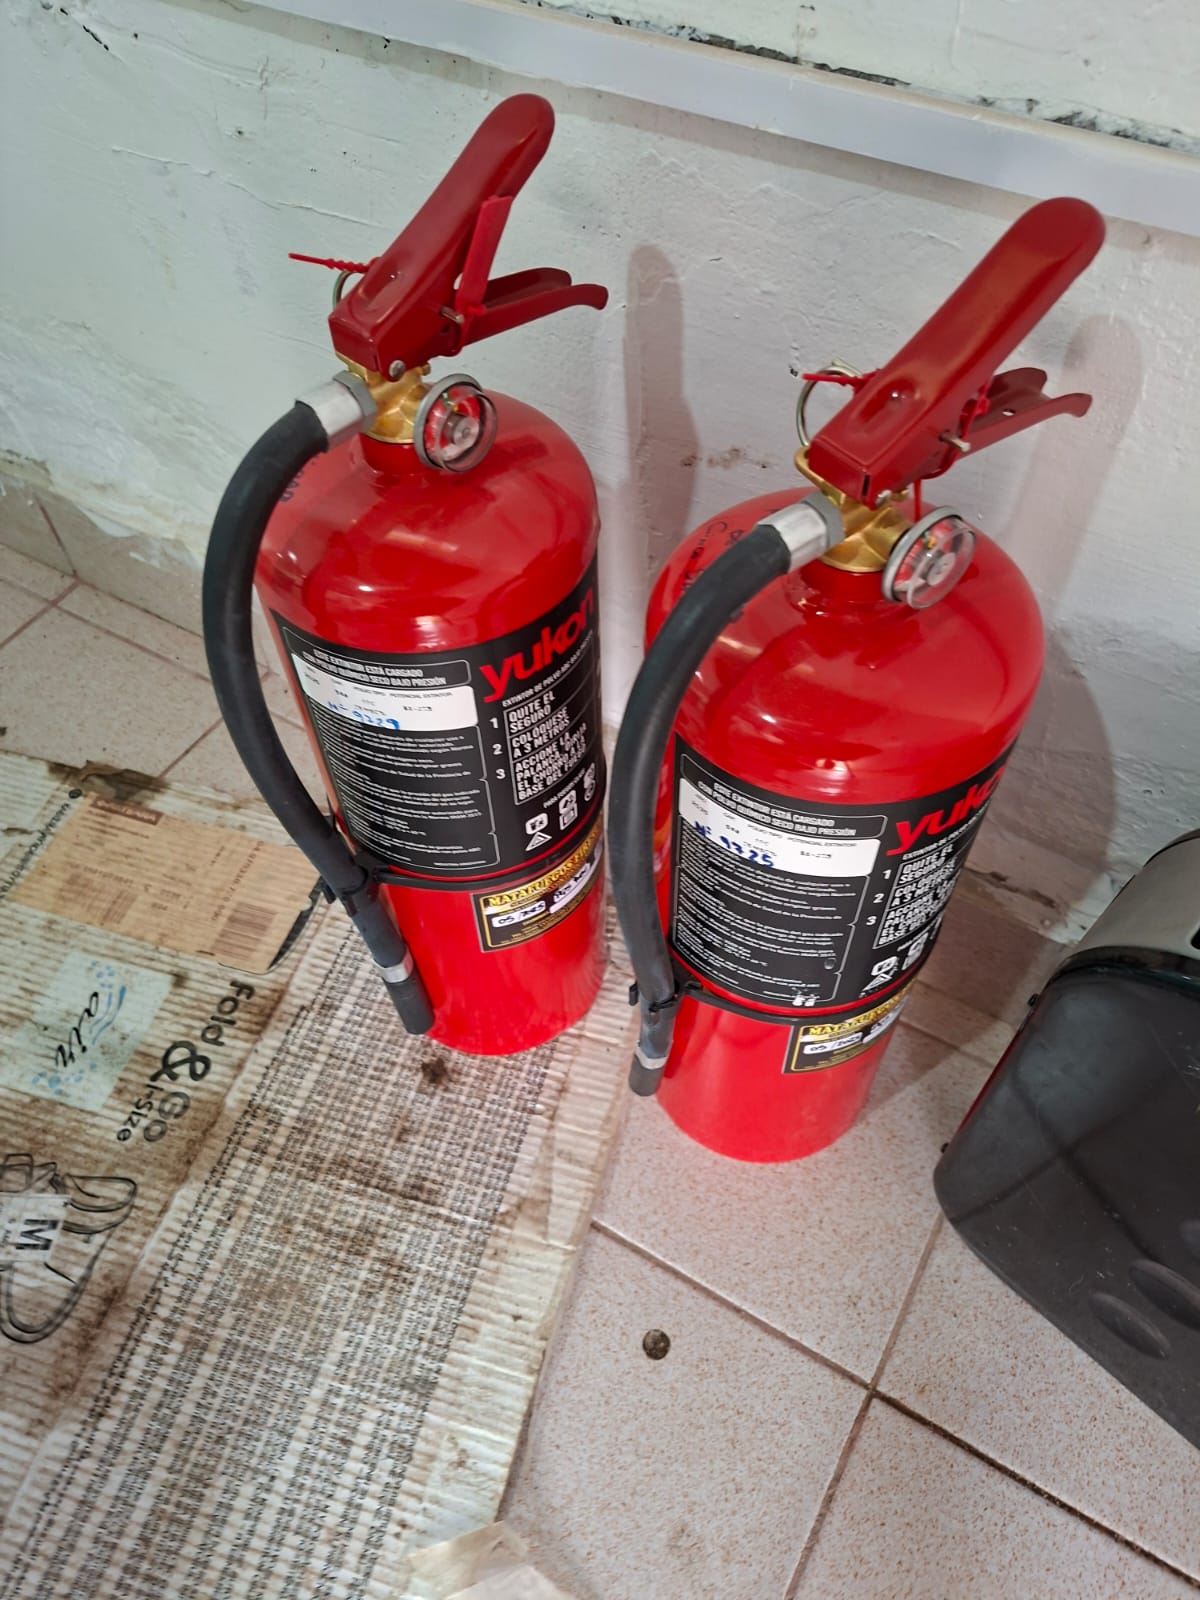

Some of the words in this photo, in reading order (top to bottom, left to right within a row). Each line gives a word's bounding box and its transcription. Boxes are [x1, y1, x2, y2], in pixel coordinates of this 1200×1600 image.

[480, 587, 593, 703] yukon
[508, 699, 541, 723] QUITE
[543, 691, 556, 705] EL
[509, 704, 551, 733] SEGURO
[489, 717, 499, 729] 1
[513, 748, 522, 758] A
[533, 717, 570, 748] METROS
[492, 743, 503, 755] 2
[515, 741, 559, 773] ACCIONE
[495, 768, 506, 779] 3
[517, 780, 531, 791] EL
[518, 781, 545, 800] BASE
[546, 769, 562, 786] DEL
[882, 869, 892, 879] 1
[902, 851, 940, 874] QUITE
[873, 893, 885, 904] 2
[891, 898, 900, 907] A
[866, 915, 877, 926] 3
[200, 980, 255, 1047] Fold
[150, 1040, 211, 1082] &
[143, 1091, 190, 1142] Go
[16, 1219, 59, 1250] M
